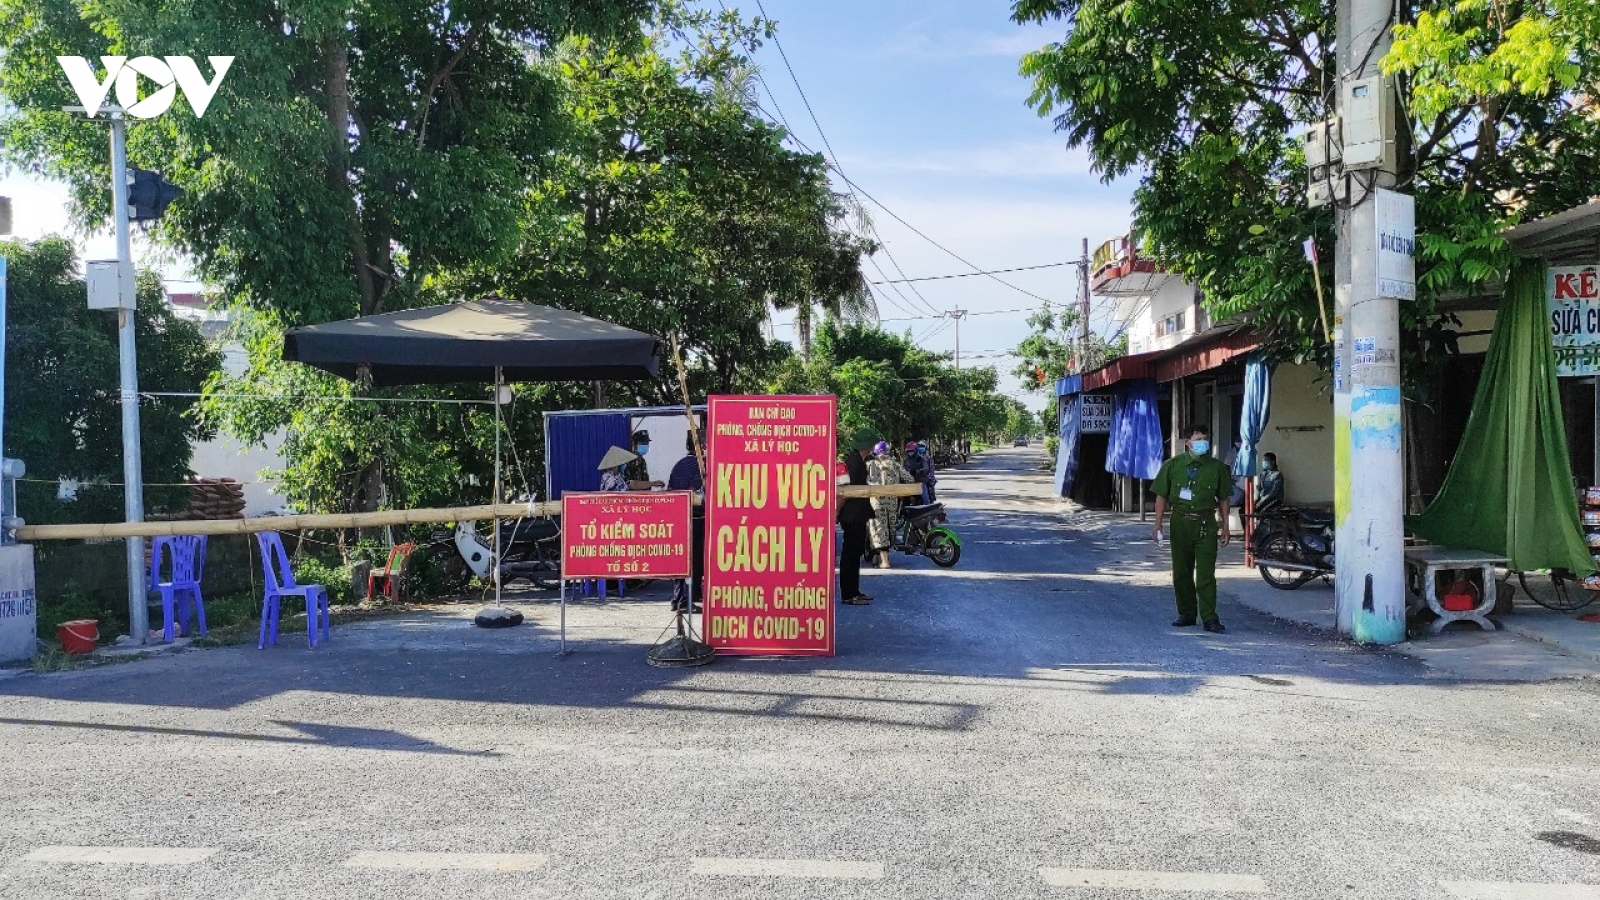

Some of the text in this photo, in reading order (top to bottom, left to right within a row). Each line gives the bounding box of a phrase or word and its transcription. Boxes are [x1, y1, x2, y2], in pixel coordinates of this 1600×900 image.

[747, 420, 772, 437] CHỐNG
[774, 424, 791, 439] DỊCH
[793, 424, 827, 437] COVID-19
[744, 439, 800, 455] XÃ LÝ HỌC
[717, 459, 826, 520] KHU VỰC
[601, 505, 652, 515] XÃ LÝ HỌC
[580, 517, 675, 540] TỔ KIỂM SOÁT
[570, 540, 684, 560] PHÒNG CHỐNG DỊCH COVID-19
[717, 515, 825, 573] CÁCH LY
[624, 559, 640, 573] SỐ
[642, 563, 650, 573] 2
[711, 578, 826, 612] PHÒNG, CHỐNG
[712, 615, 825, 644] DỊCH COVID-19
